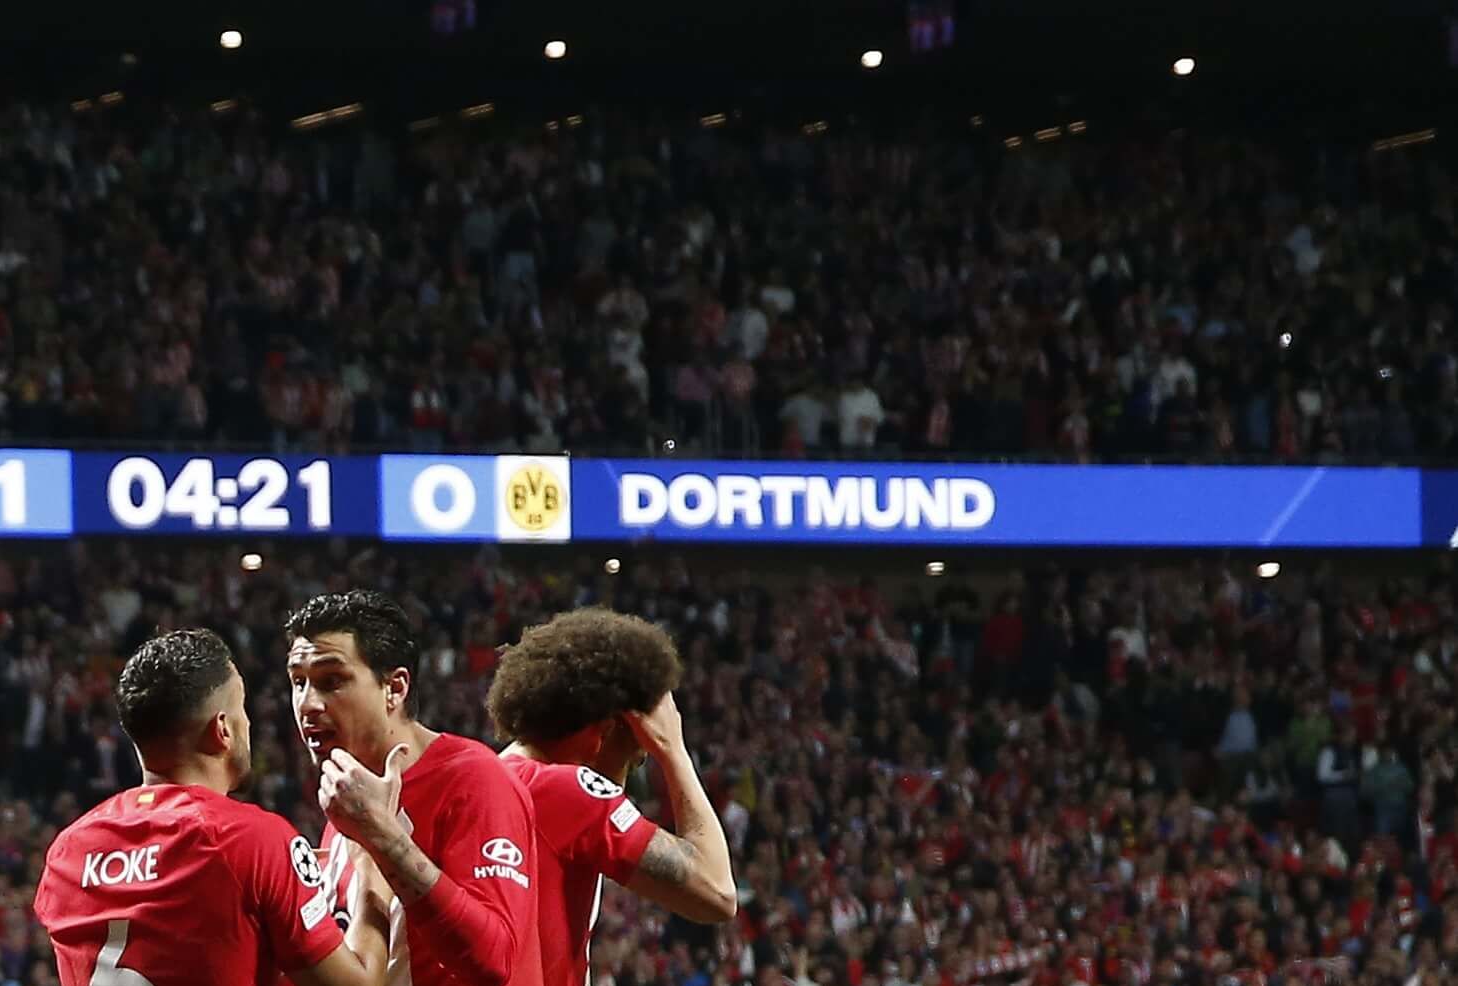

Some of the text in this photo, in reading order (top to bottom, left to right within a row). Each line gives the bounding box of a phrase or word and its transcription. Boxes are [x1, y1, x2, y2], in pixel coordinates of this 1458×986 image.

[109, 457, 332, 528] 04:21
[410, 463, 477, 532] 0
[620, 474, 995, 529] DORTMUND
[82, 845, 161, 888] KOKE
